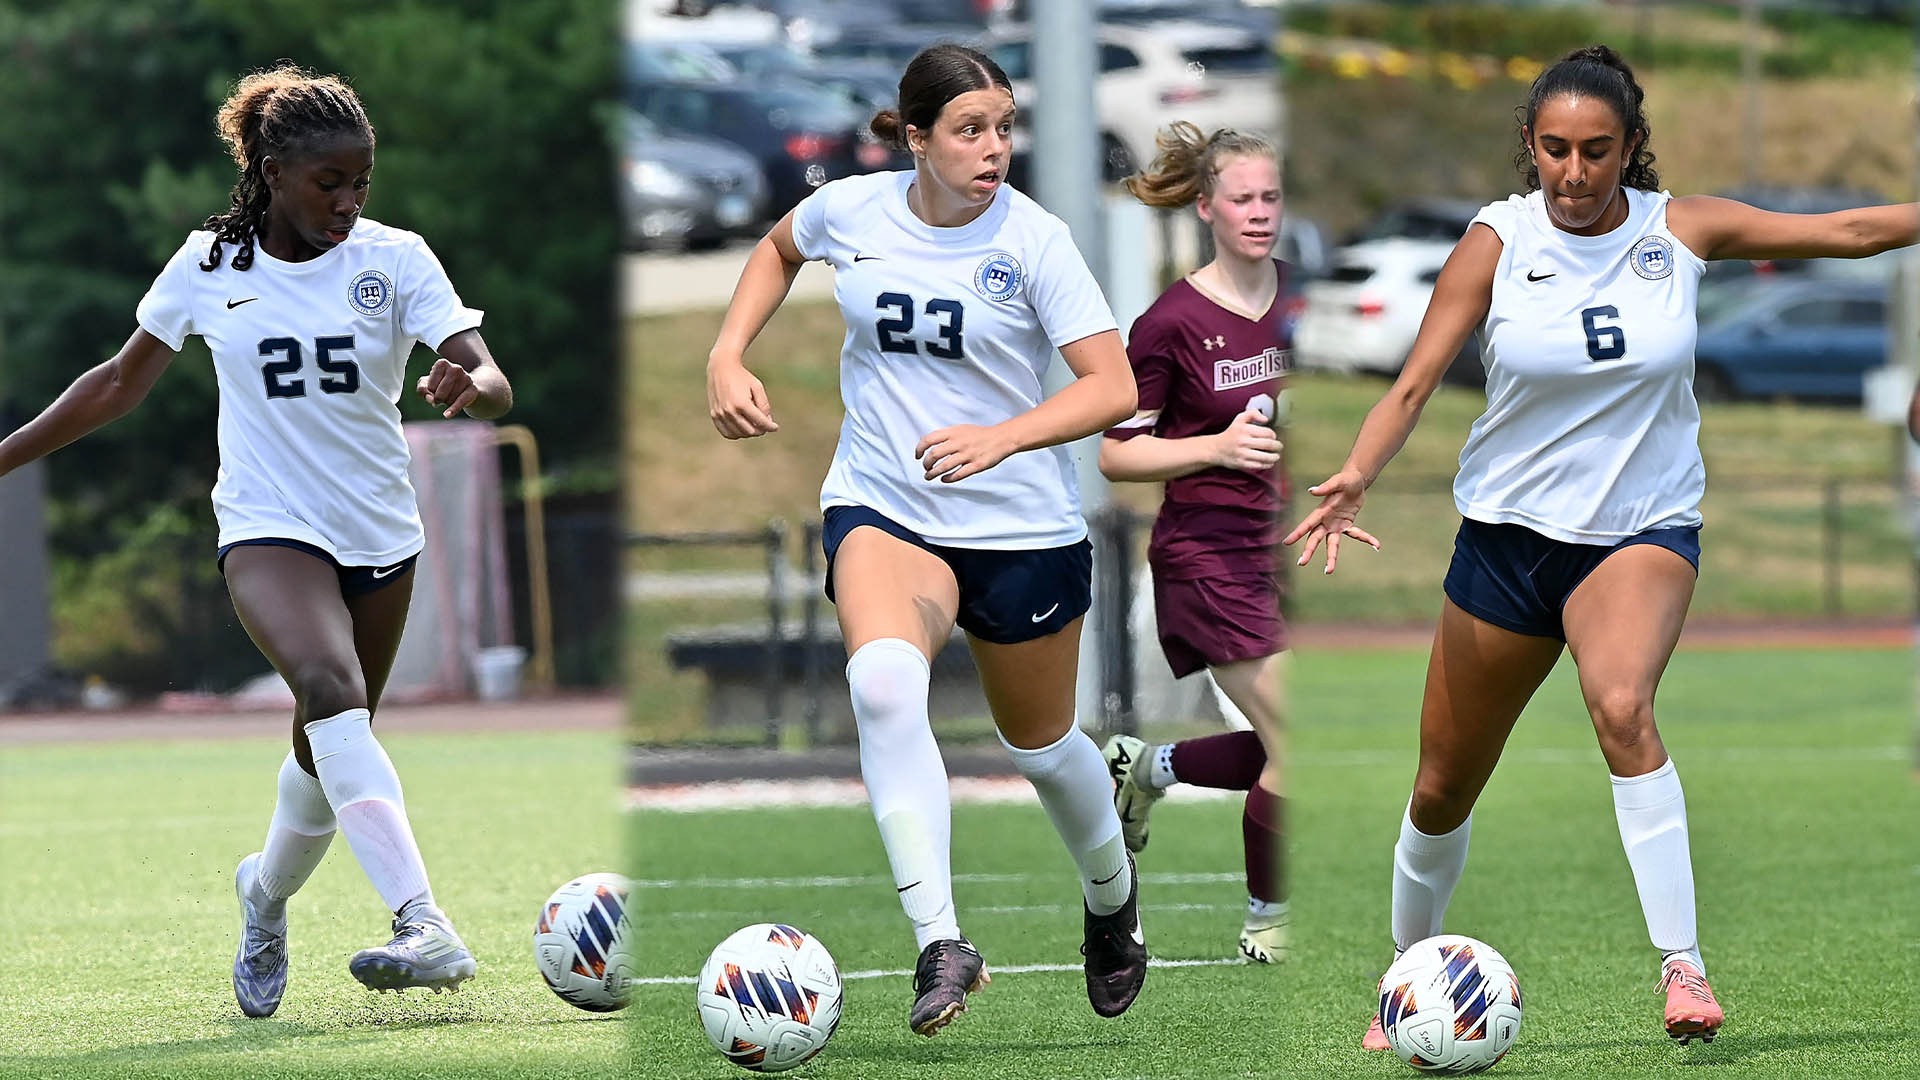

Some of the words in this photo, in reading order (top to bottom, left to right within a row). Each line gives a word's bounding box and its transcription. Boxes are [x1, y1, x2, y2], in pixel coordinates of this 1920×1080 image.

[876, 292, 964, 360] 23
[1581, 304, 1627, 362] 6
[257, 334, 360, 400] 25
[1221, 361, 1263, 384] RHODE
